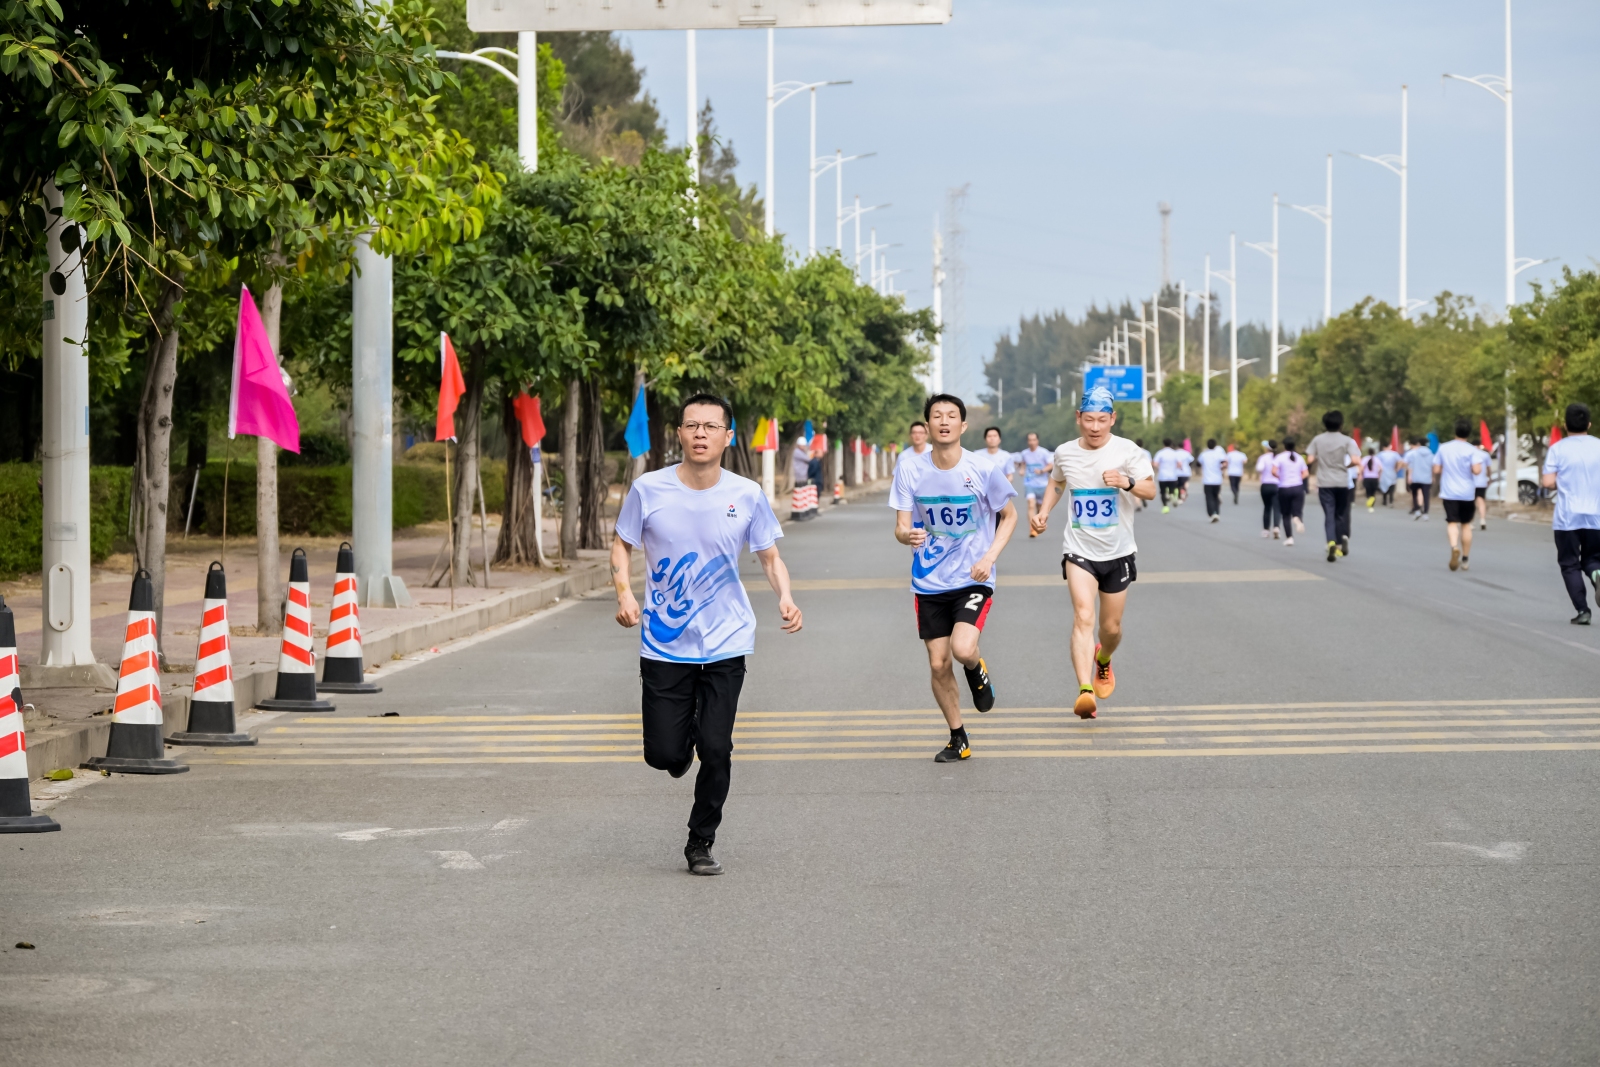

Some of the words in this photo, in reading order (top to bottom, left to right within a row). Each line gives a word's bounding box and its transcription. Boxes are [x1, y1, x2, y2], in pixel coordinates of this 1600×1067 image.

[925, 506, 969, 527] 165
[1073, 499, 1114, 519] 093
[964, 593, 984, 612] 2
